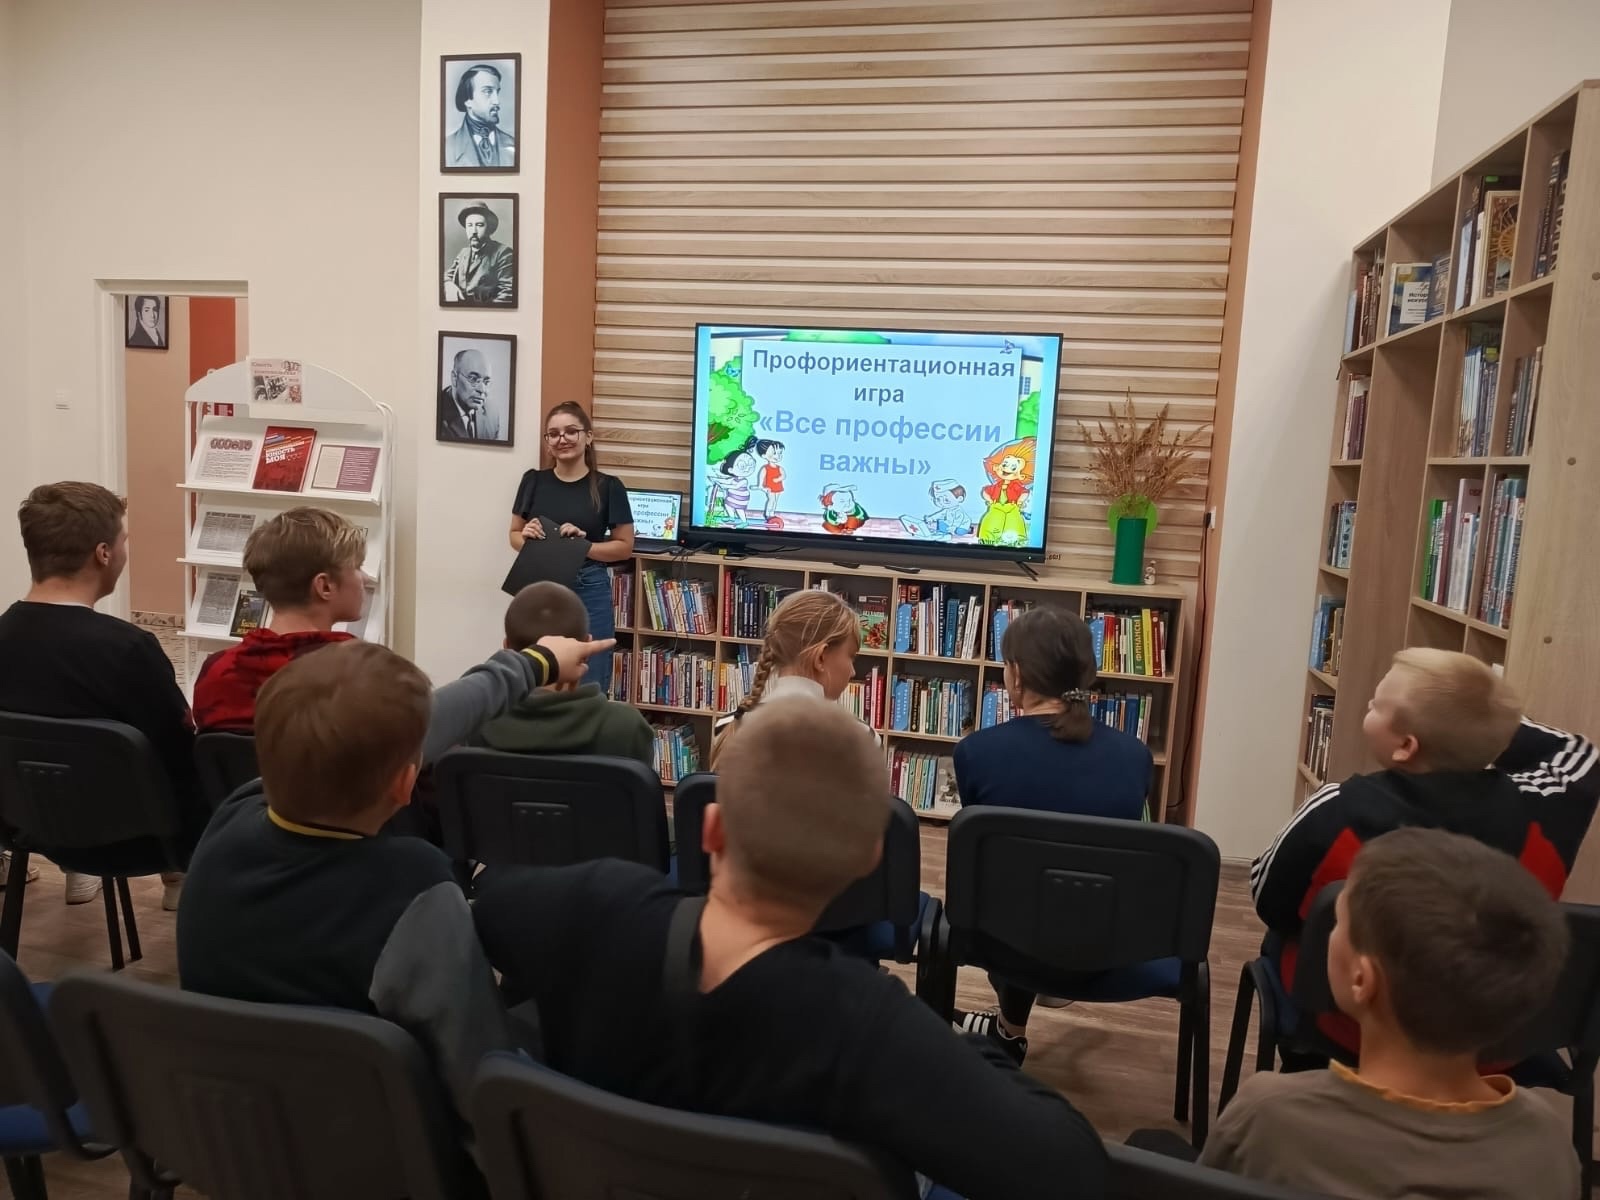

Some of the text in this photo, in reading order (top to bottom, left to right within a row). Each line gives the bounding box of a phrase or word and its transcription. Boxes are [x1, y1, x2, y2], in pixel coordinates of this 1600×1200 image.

[753, 350, 1015, 378] Профориентационная
[854, 386, 905, 404] игра
[759, 410, 1001, 443] «Все профессии
[819, 453, 932, 476] важны»
[1134, 619, 1142, 661] ФИНАНСЫ
